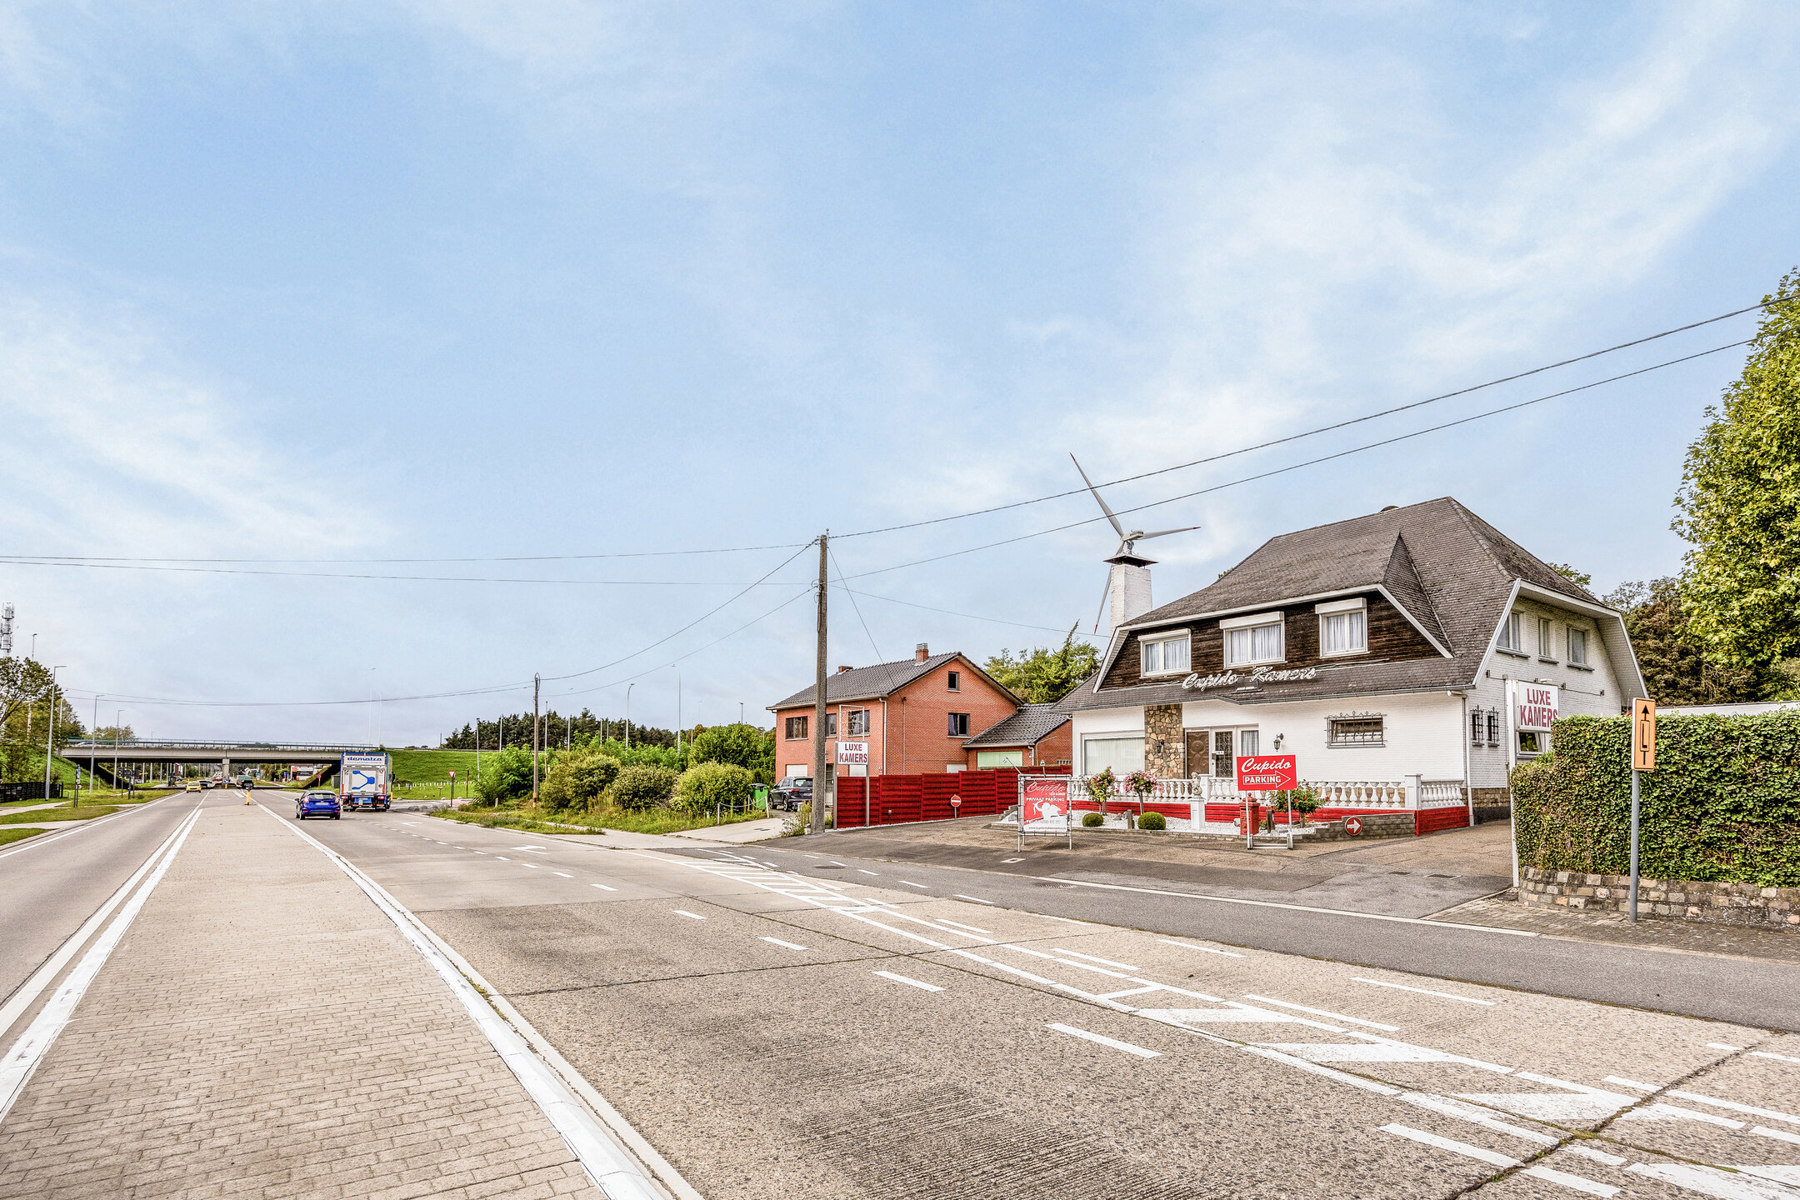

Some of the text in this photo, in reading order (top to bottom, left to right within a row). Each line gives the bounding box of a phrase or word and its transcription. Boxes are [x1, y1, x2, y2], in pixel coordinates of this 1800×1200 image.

[1181, 666, 1317, 692] Cupido Kamers
[1527, 688, 1551, 706] LUXE
[844, 743, 863, 751] LUXE
[839, 753, 868, 763] KAMERS
[1241, 758, 1292, 773] Cupido
[1244, 776, 1282, 784] PARKING
[1026, 782, 1066, 793] Cupido
